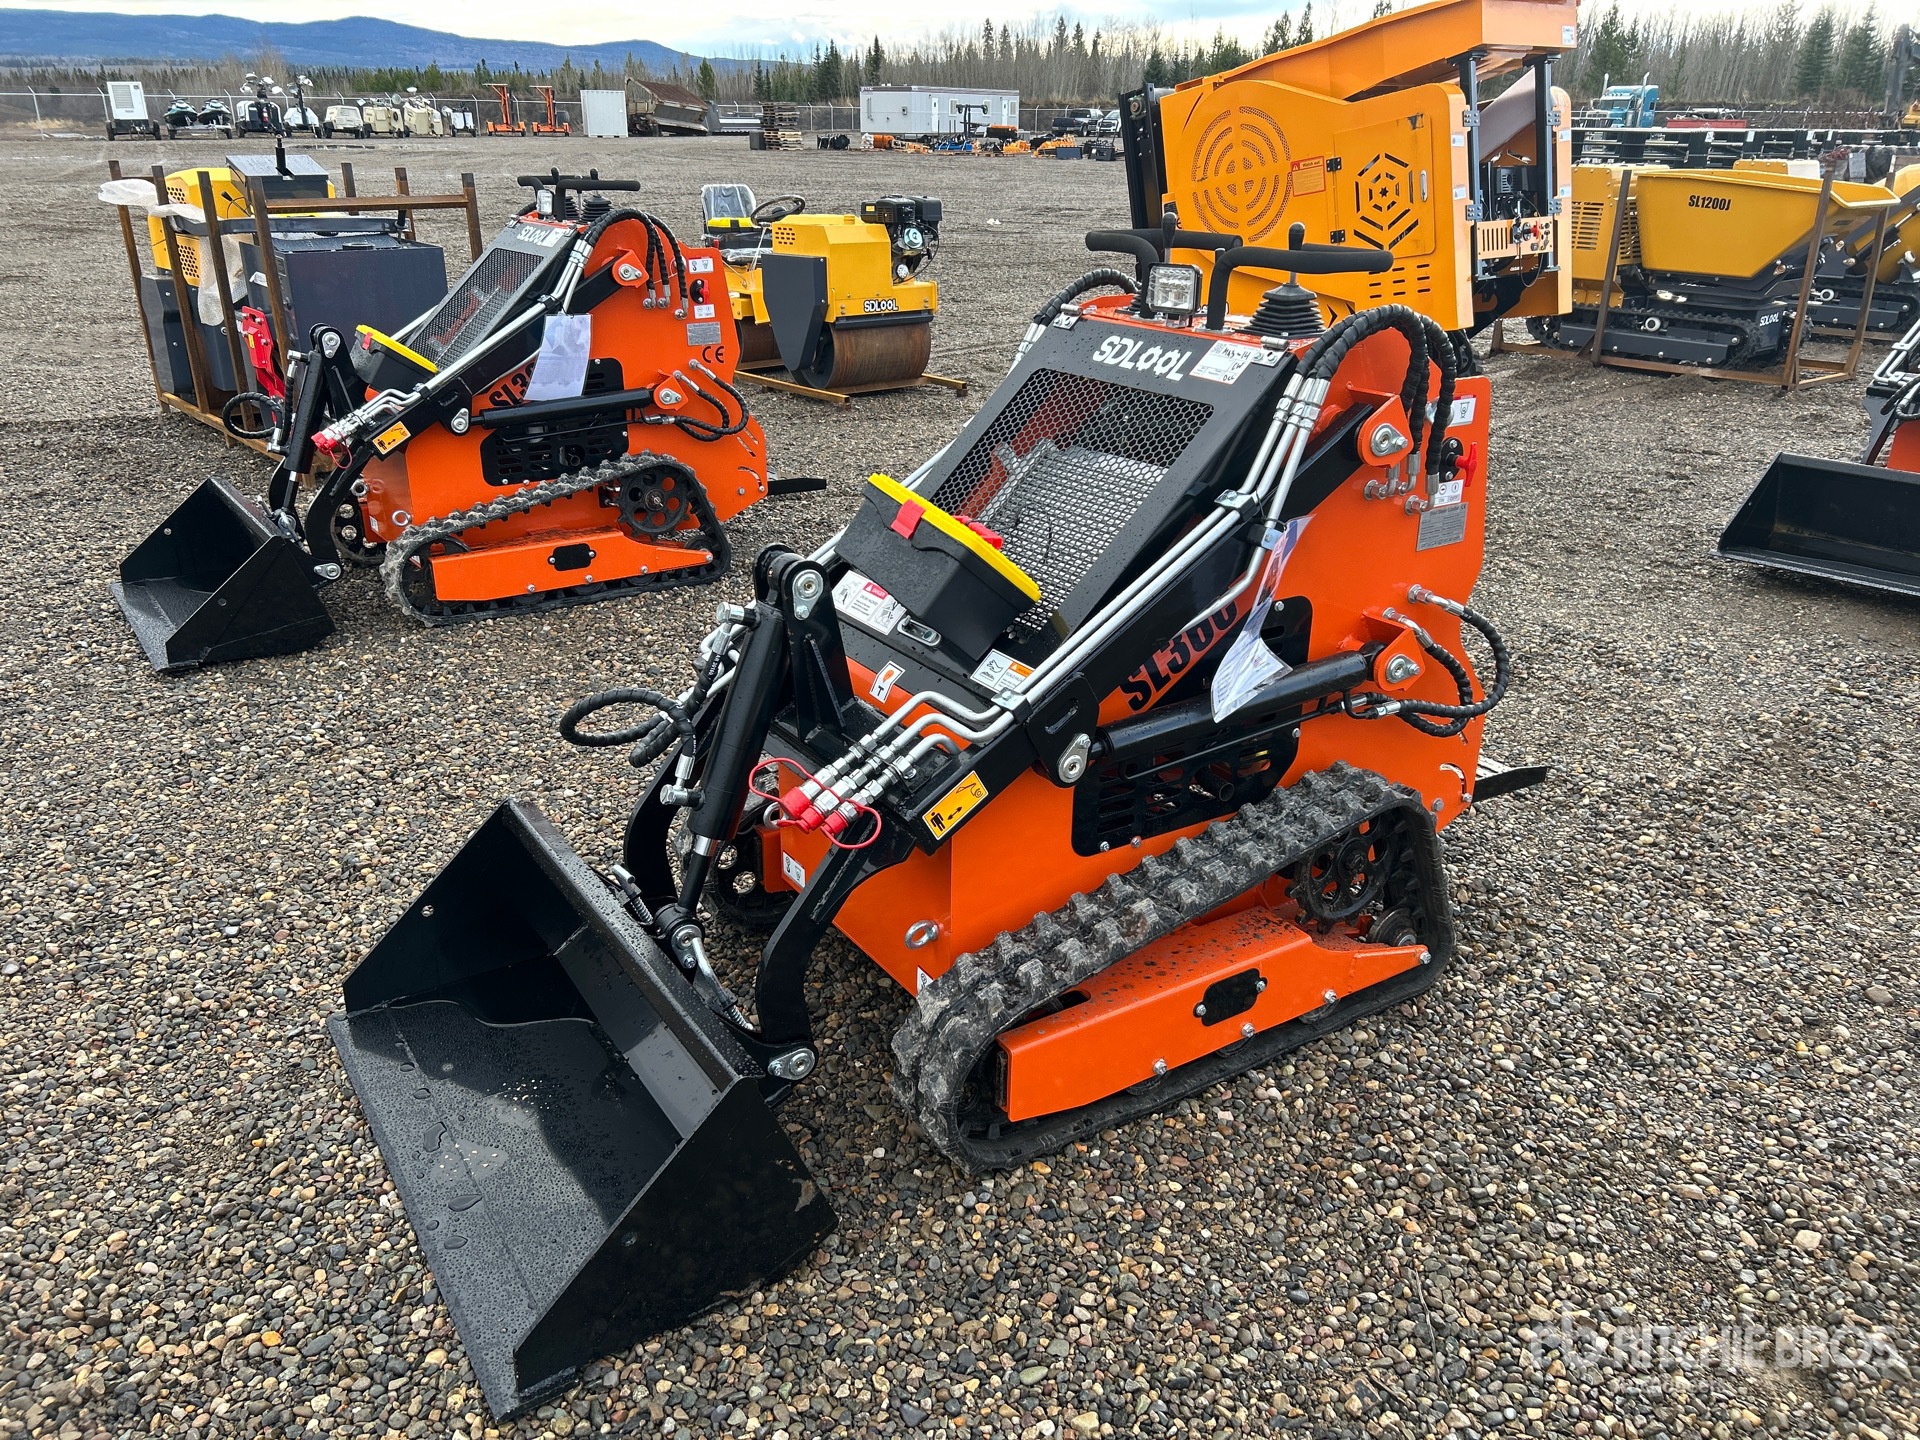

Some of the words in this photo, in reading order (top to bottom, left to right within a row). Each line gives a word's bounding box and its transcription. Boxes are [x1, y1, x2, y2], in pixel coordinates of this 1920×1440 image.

[1688, 195, 1731, 211] SL1200J
[863, 298, 900, 313] SDLOOL
[702, 346, 724, 363] CE
[1092, 335, 1192, 382] SDLOOL
